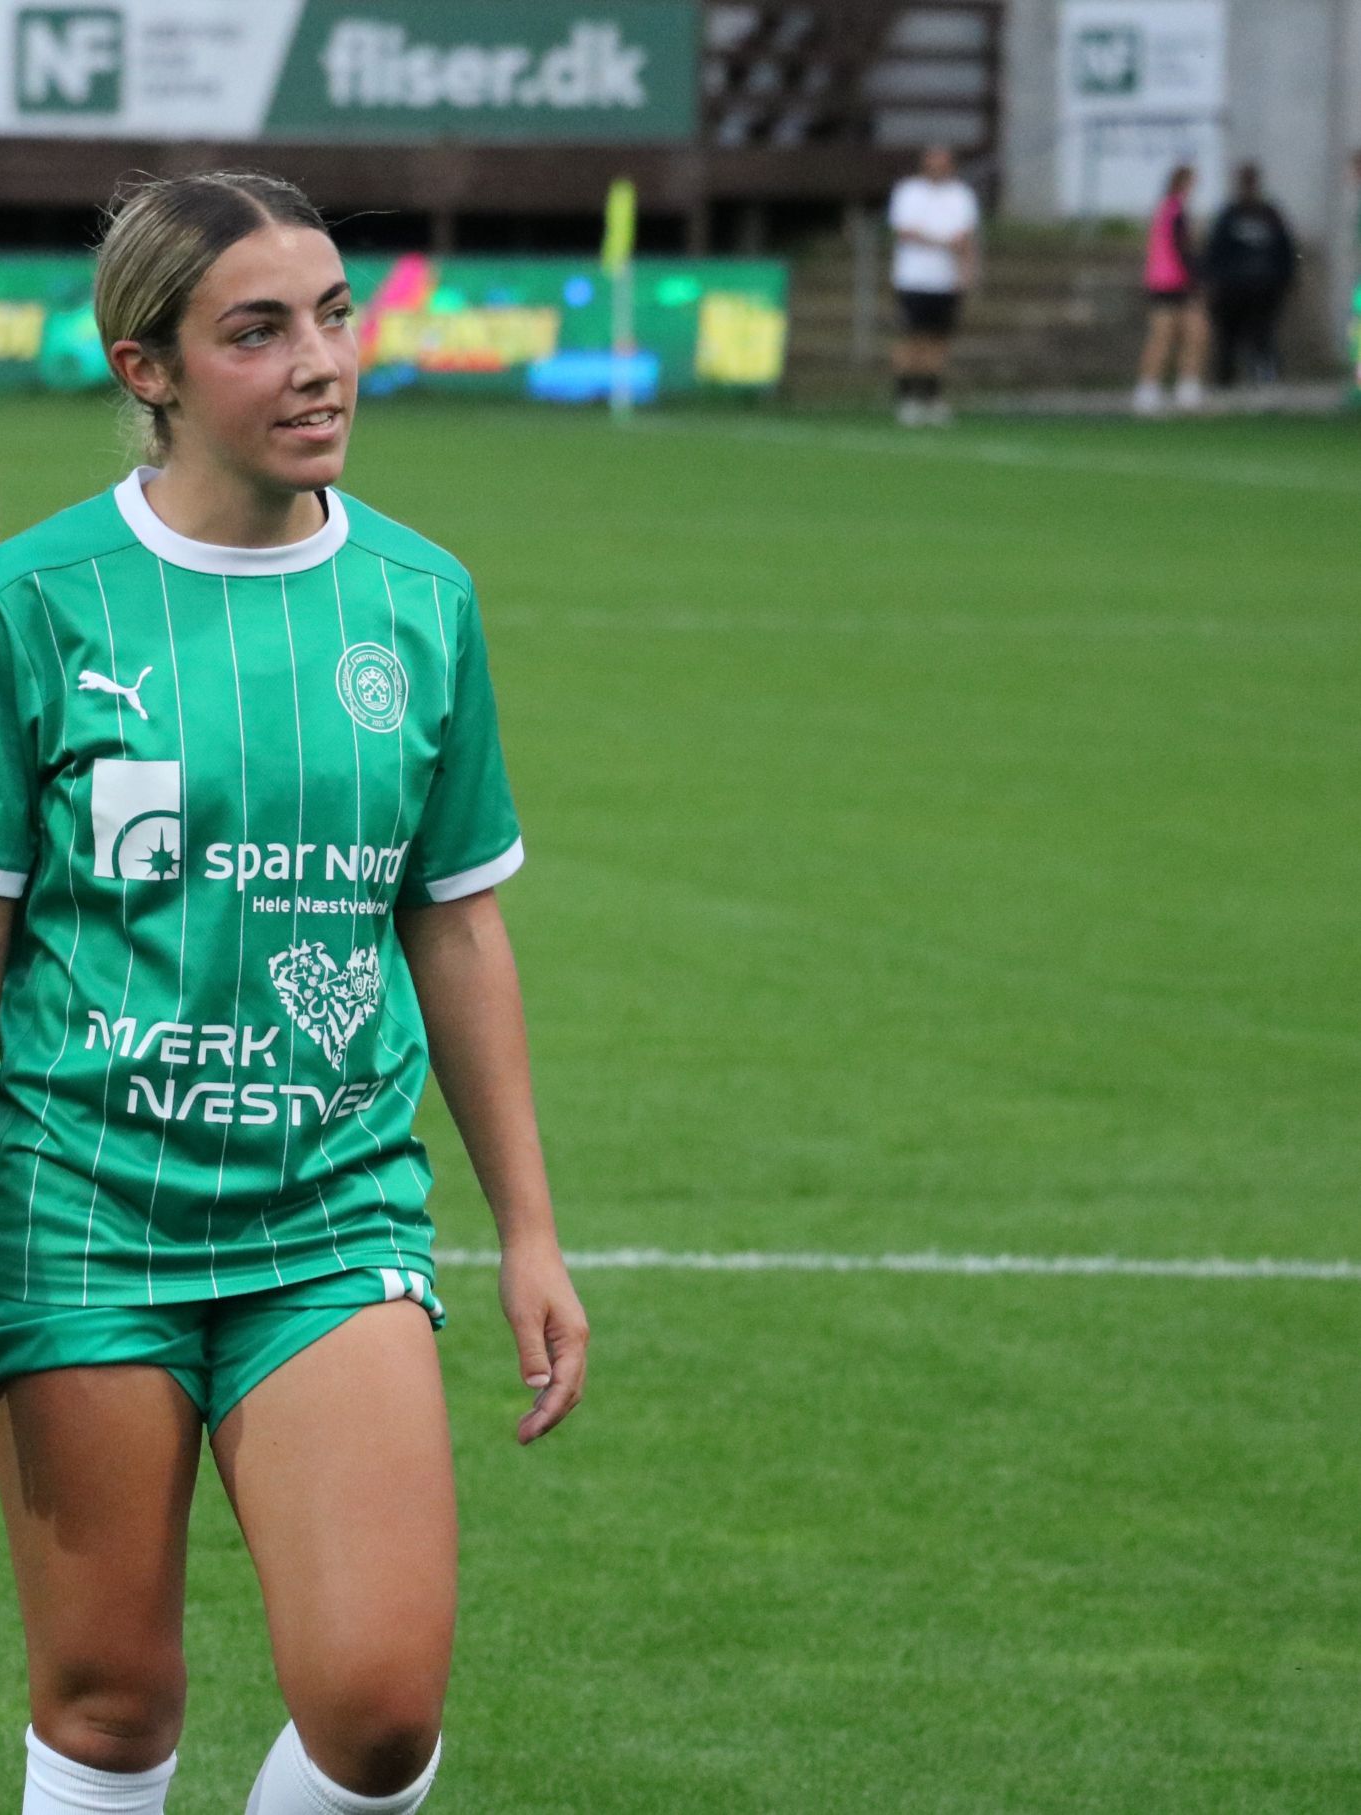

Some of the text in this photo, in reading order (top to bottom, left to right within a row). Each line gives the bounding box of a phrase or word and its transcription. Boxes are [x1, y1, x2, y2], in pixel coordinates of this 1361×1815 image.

[25, 17, 117, 104] NF
[321, 19, 647, 108] fliser.dk
[204, 840, 410, 892] spar Nord
[252, 896, 291, 913] Hele
